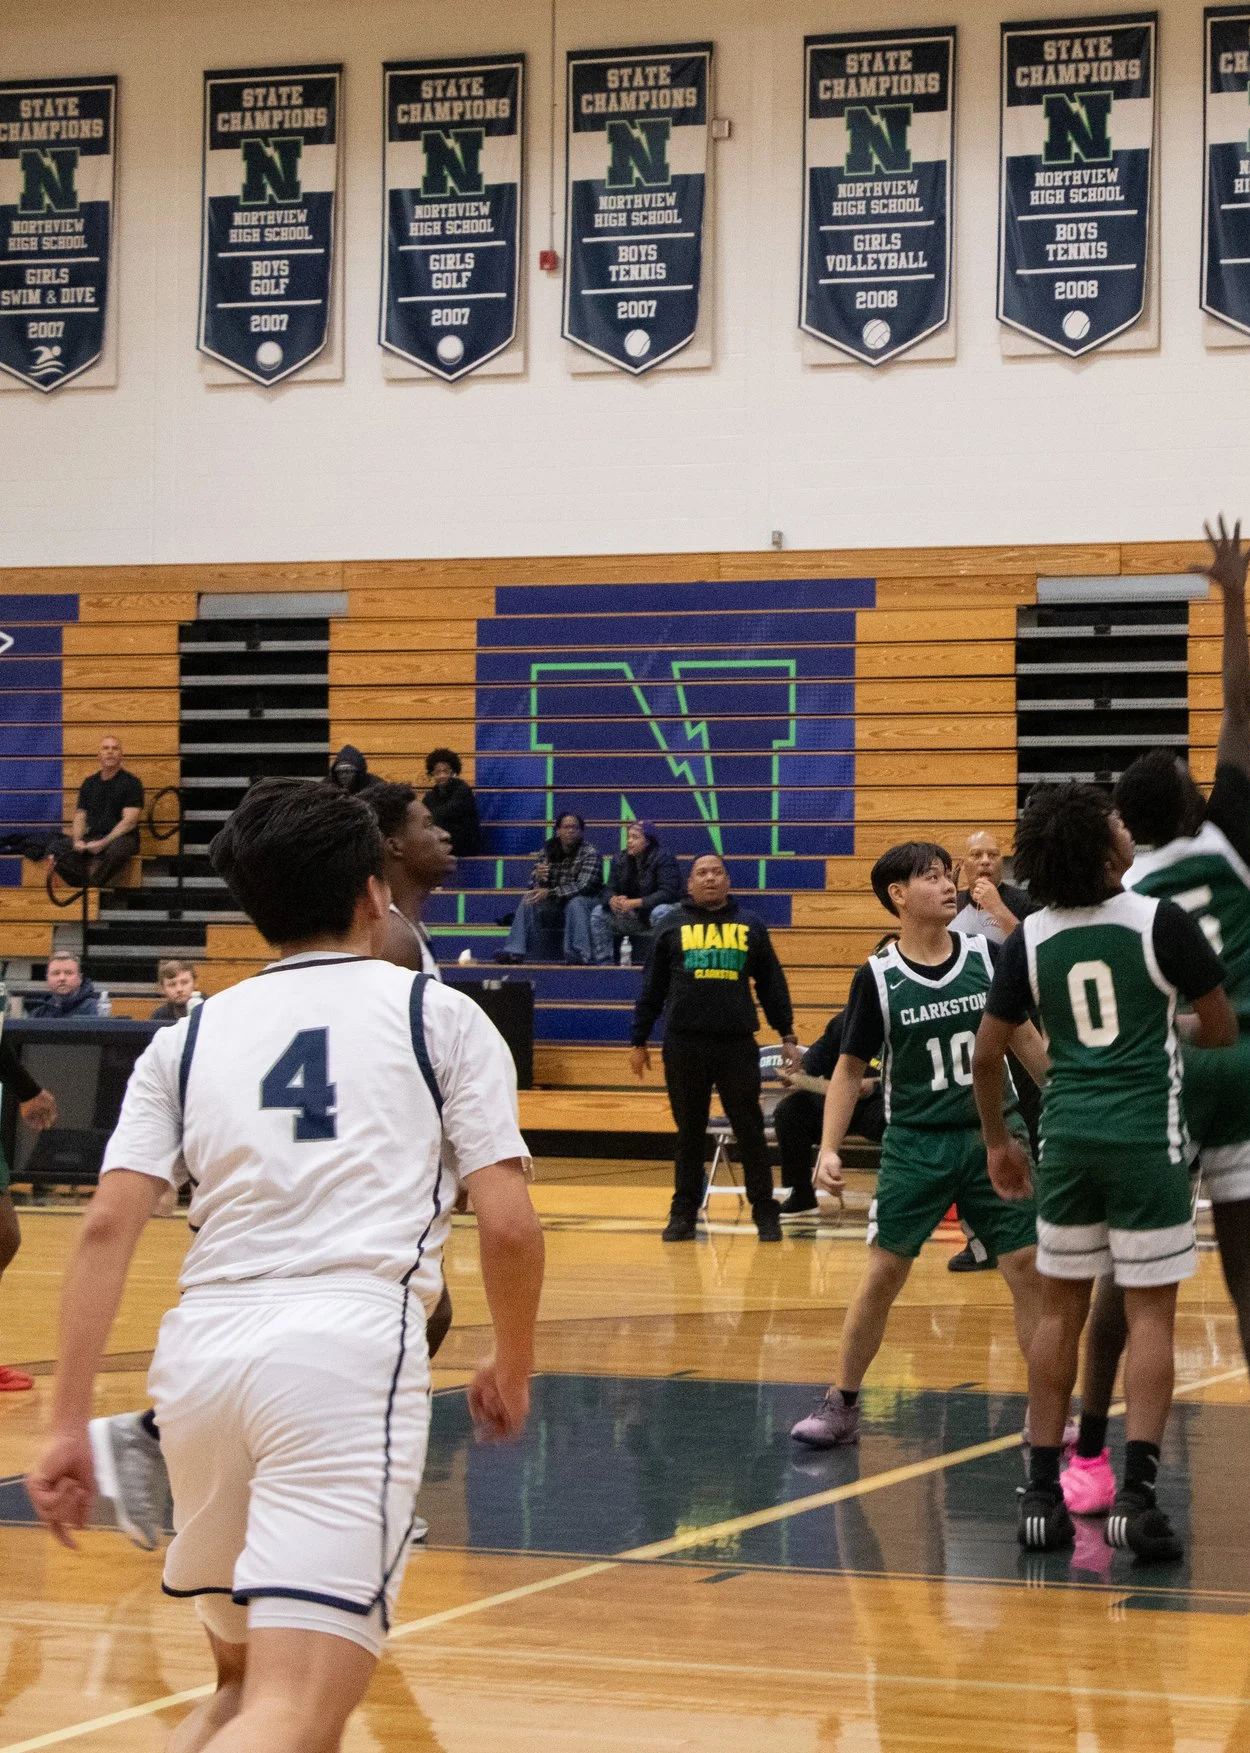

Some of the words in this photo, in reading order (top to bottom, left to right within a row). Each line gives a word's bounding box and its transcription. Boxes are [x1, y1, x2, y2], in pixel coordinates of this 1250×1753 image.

[1043, 36, 1112, 61] STATE
[846, 50, 912, 74] STATE
[607, 65, 671, 89] STATE
[1016, 59, 1141, 88] CHAMPIONS
[421, 76, 484, 98] STATE
[819, 73, 940, 100] CHAMPIONS
[242, 86, 303, 108] STATE
[581, 87, 697, 114] CHAMPIONS
[20, 98, 79, 118] STATE
[397, 98, 510, 124] CHAMPIONS
[217, 107, 328, 132] CHAMPIONS
[1042, 90, 1114, 165] N
[0, 119, 104, 142] CHAMPIONS
[844, 103, 913, 176] N
[420, 127, 486, 198] N
[606, 117, 672, 189] N
[240, 136, 304, 205] N
[1035, 168, 1119, 187] NORTHVIEW
[18, 147, 80, 214] N
[837, 179, 918, 198] NORTHVIEW
[599, 192, 677, 210] NORTHVIEW
[1030, 189, 1065, 206] HIGH
[1069, 186, 1124, 203] SCHOOL
[414, 201, 491, 219] NORTHVIEW
[832, 201, 865, 217] HIGH
[870, 198, 923, 215] SCHOOL
[11, 219, 85, 235] NORTHVIEW
[233, 209, 307, 226] NORTHVIEW
[409, 221, 441, 236] HIGH
[445, 218, 494, 234] SCHOOL
[594, 212, 628, 228] HIGH
[631, 209, 682, 225] SCHOOL
[229, 228, 260, 244] HIGH
[264, 225, 313, 241] SCHOOL
[1055, 222, 1098, 241] BOYS
[8, 236, 37, 251] HIGH
[42, 235, 88, 250] SCHOOL
[853, 233, 901, 251] GIRLS
[1046, 242, 1108, 261] TENNIS
[429, 253, 475, 271] GIRLS
[617, 244, 657, 263] BOYS
[826, 252, 927, 272] VOLLEYBALL
[25, 268, 69, 285] GIRLS
[251, 260, 289, 277] BOYS
[609, 263, 666, 282] TENNIS
[251, 278, 289, 296] GOLF
[432, 271, 472, 289] GOLF
[1, 288, 41, 306] SWIM
[46, 290, 57, 304] &
[60, 287, 95, 304] DIVE
[856, 290, 898, 309] 2008
[1054, 280, 1099, 300] 2008
[431, 308, 470, 326] 2007
[617, 300, 657, 319] 2007
[27, 321, 65, 339] 2007
[250, 314, 289, 332] 2007
[681, 923, 749, 952] MAKE
[900, 991, 988, 1026] CLARKSTON
[1067, 959, 1120, 1048] 0
[926, 1031, 975, 1092] 10
[259, 1026, 338, 1143] 4
